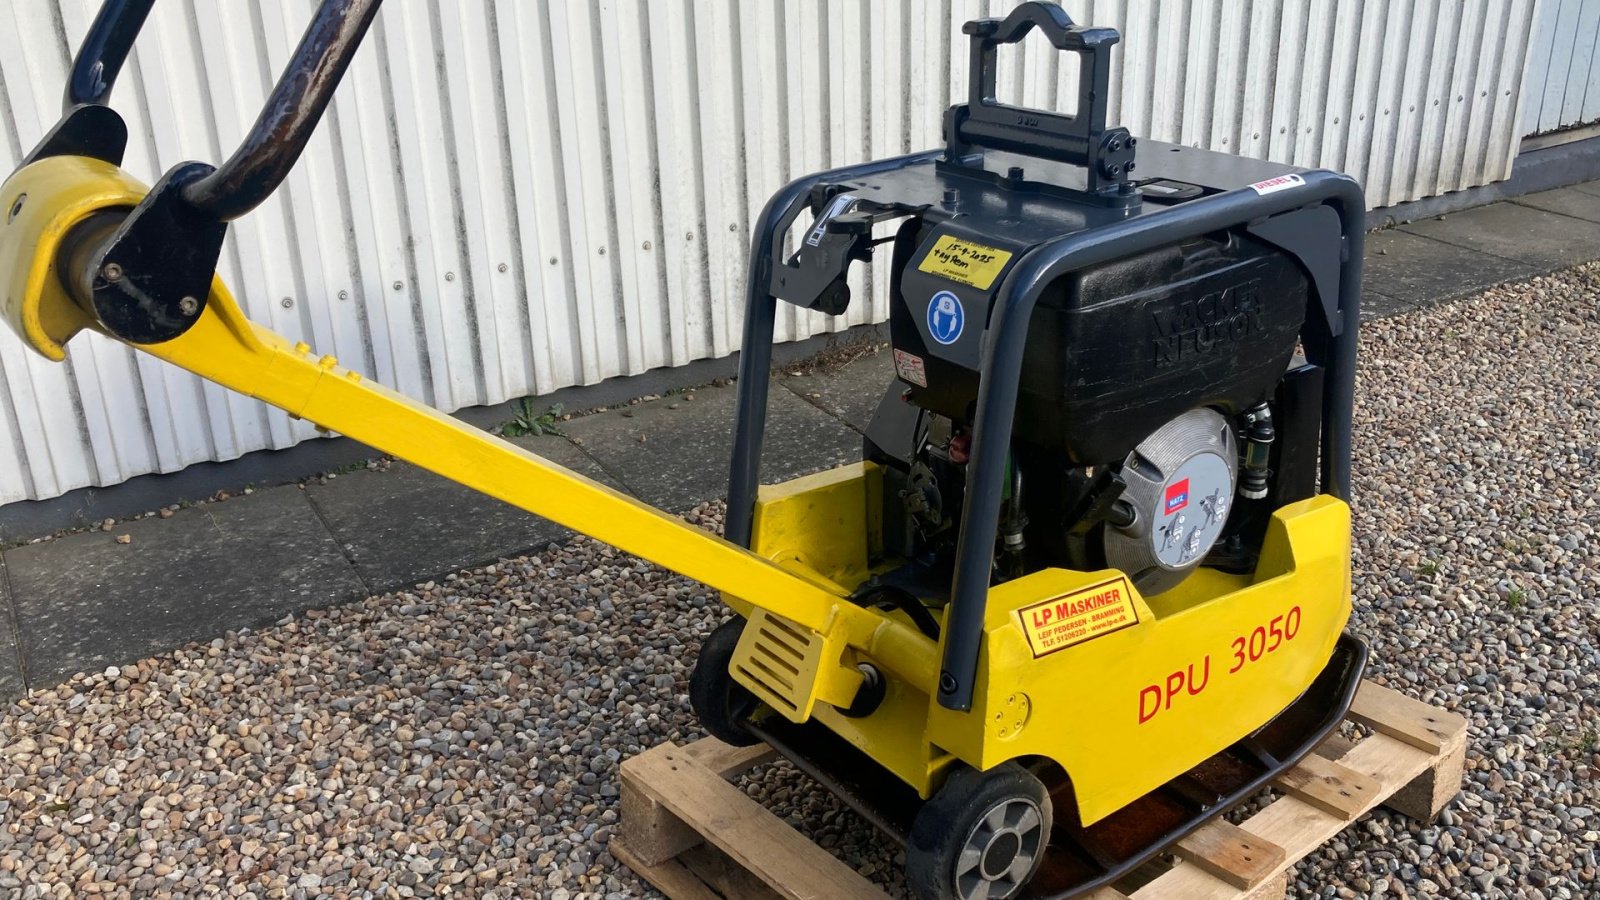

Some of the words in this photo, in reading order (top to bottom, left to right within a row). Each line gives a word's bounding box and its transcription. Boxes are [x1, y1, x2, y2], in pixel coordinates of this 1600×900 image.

[1255, 177, 1291, 190] DIESEL
[1152, 277, 1263, 337] WACKER
[1033, 608, 1053, 628] LP
[1056, 589, 1121, 621] MASKINER
[1038, 630, 1053, 640] LEIF
[1054, 617, 1088, 635] PEDERSEN
[1091, 605, 1126, 622] BRAMMING
[1057, 627, 1087, 643] 51206220
[1091, 615, 1127, 632] www.lp-e.dk
[1138, 655, 1210, 725] DPU
[1229, 605, 1302, 674] 3050
